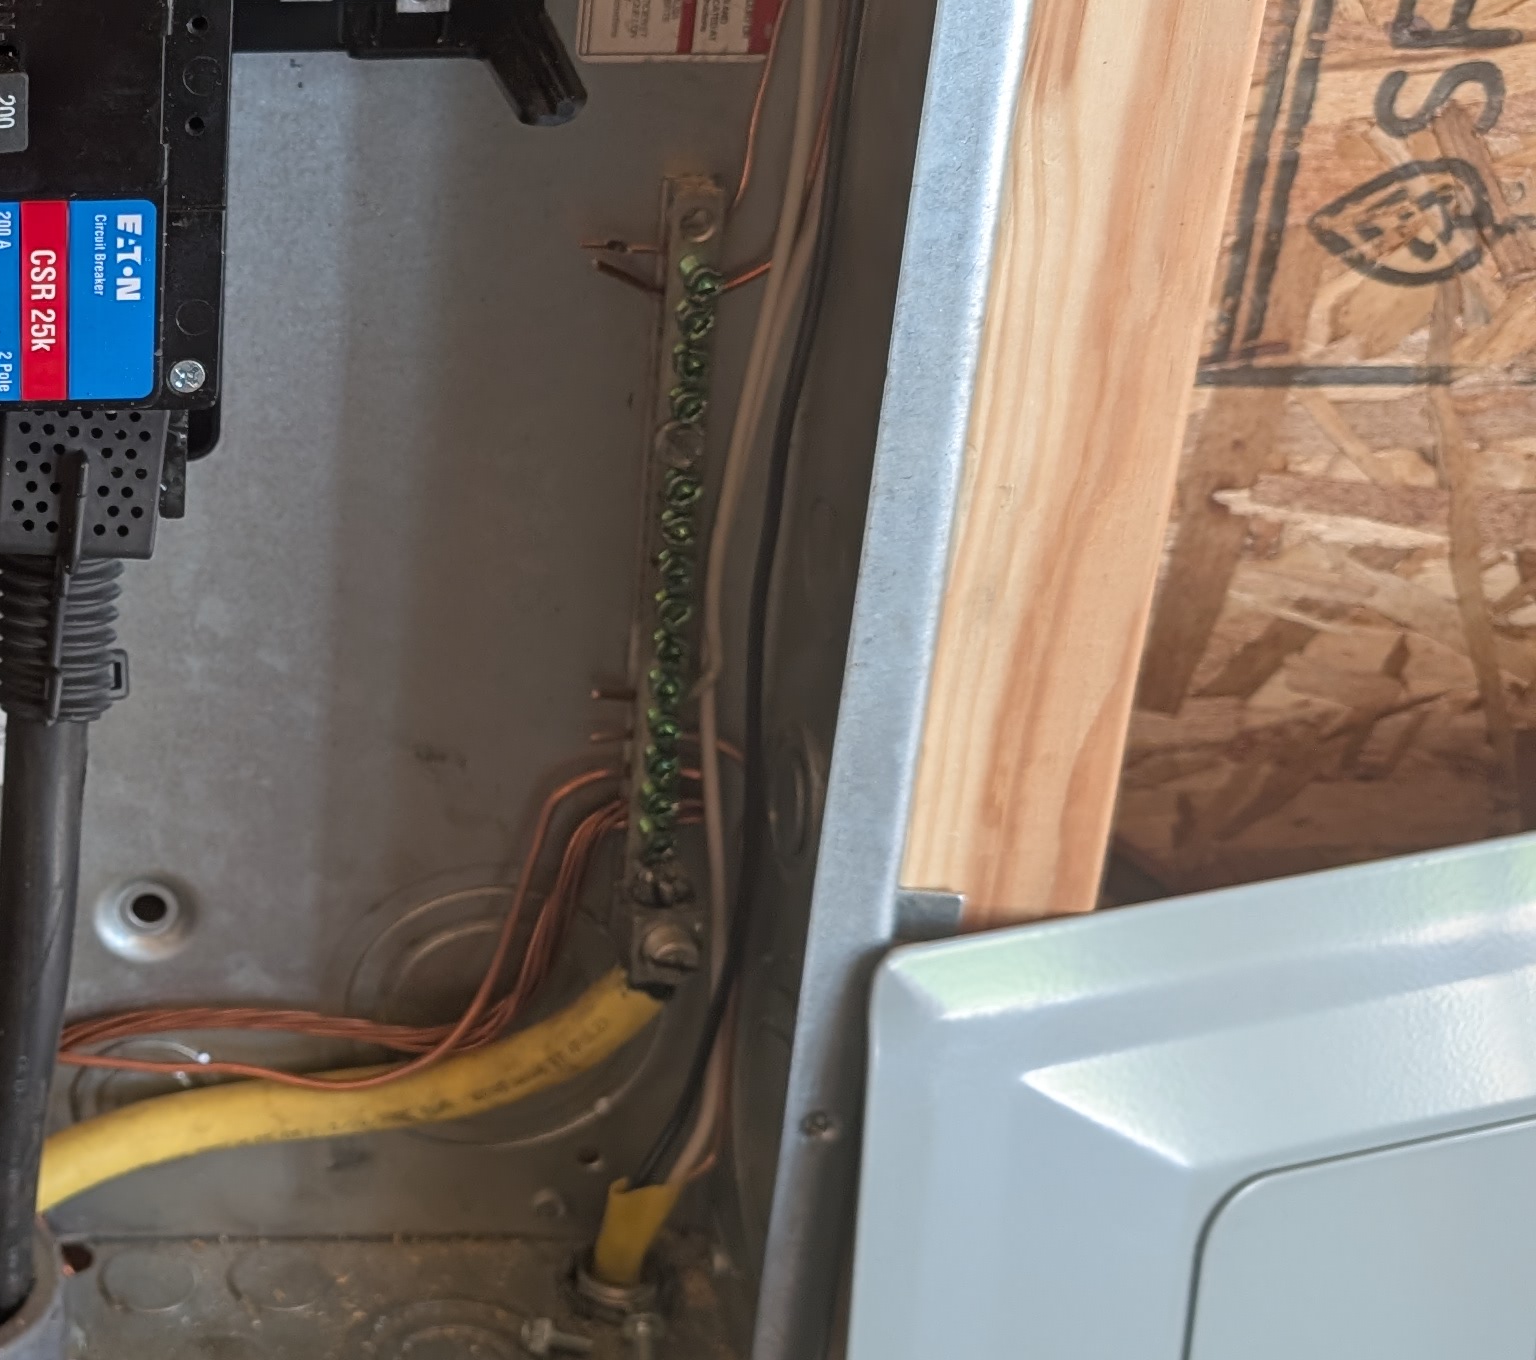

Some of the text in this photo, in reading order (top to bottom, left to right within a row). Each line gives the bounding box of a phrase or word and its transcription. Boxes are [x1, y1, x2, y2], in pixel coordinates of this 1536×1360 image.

[94, 214, 107, 296] Circuit Breaker
[116, 214, 142, 301] EATON
[30, 249, 56, 352] CSR 25k
